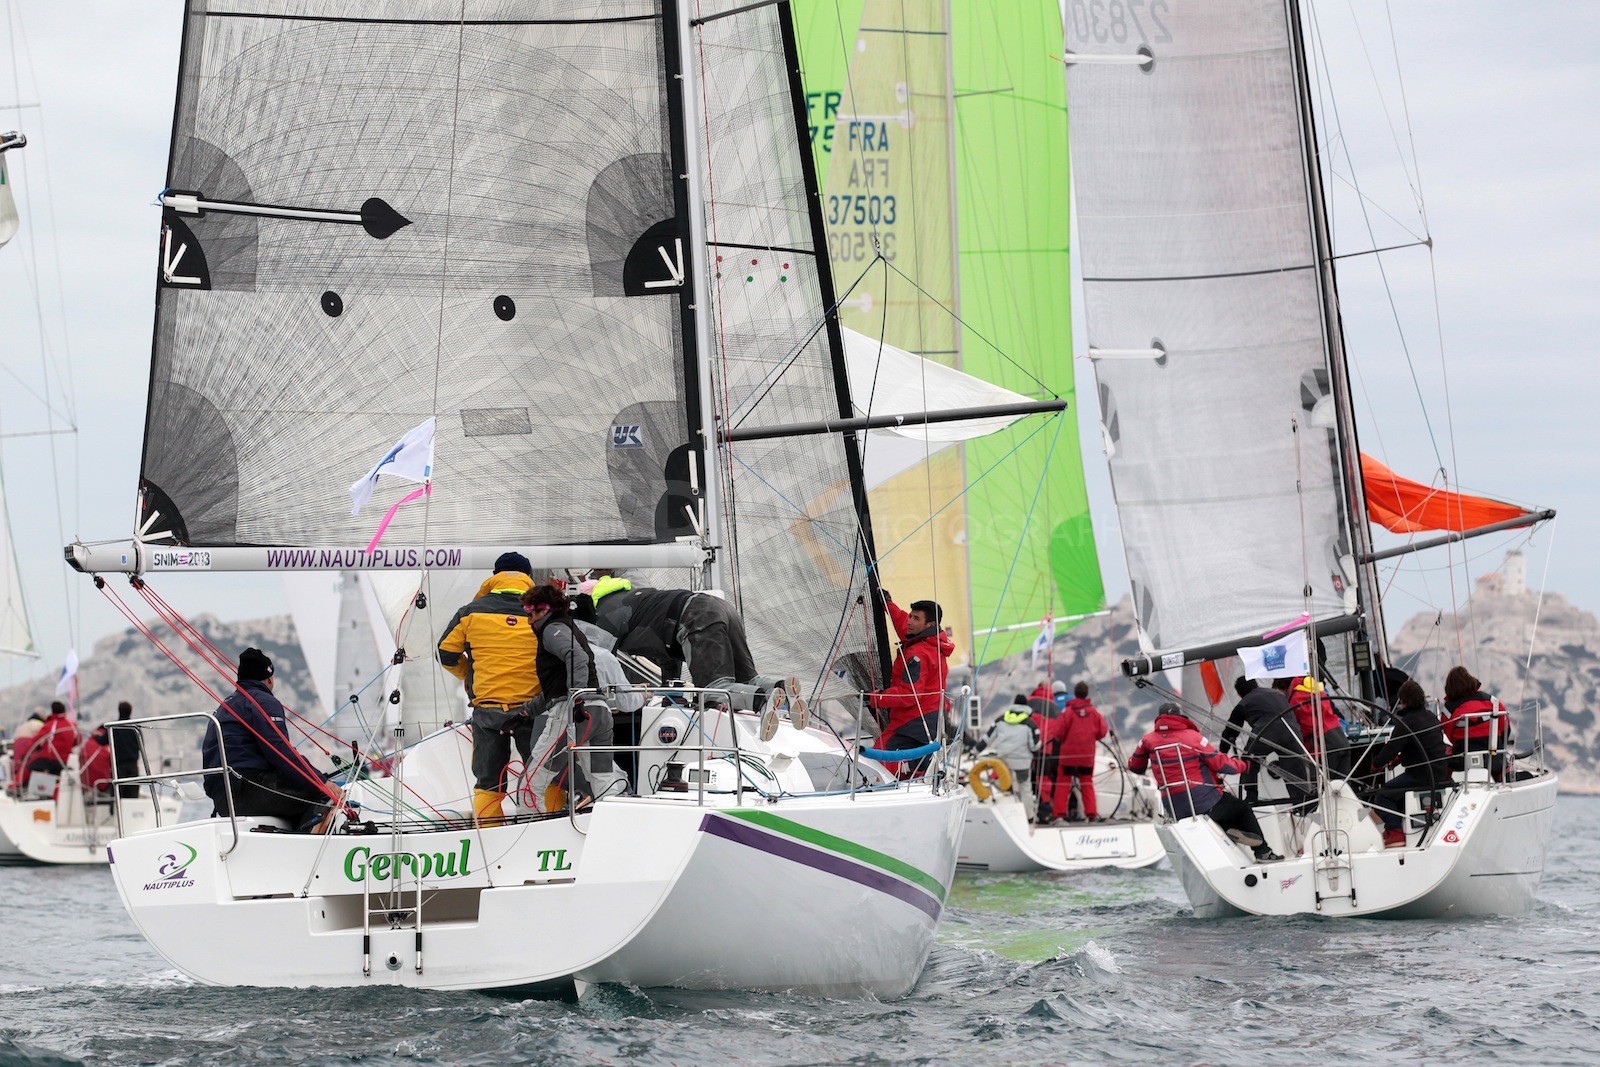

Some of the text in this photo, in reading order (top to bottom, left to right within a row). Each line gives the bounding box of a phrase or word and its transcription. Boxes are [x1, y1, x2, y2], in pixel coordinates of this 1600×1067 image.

[849, 122, 889, 151] FRA
[829, 196, 896, 225] 37503
[613, 425, 642, 444] UK
[267, 549, 461, 568] WWW.NAUTIPLUS.COM
[344, 839, 572, 882] Geroul TL
[143, 879, 195, 891] NAUTIPLUS
